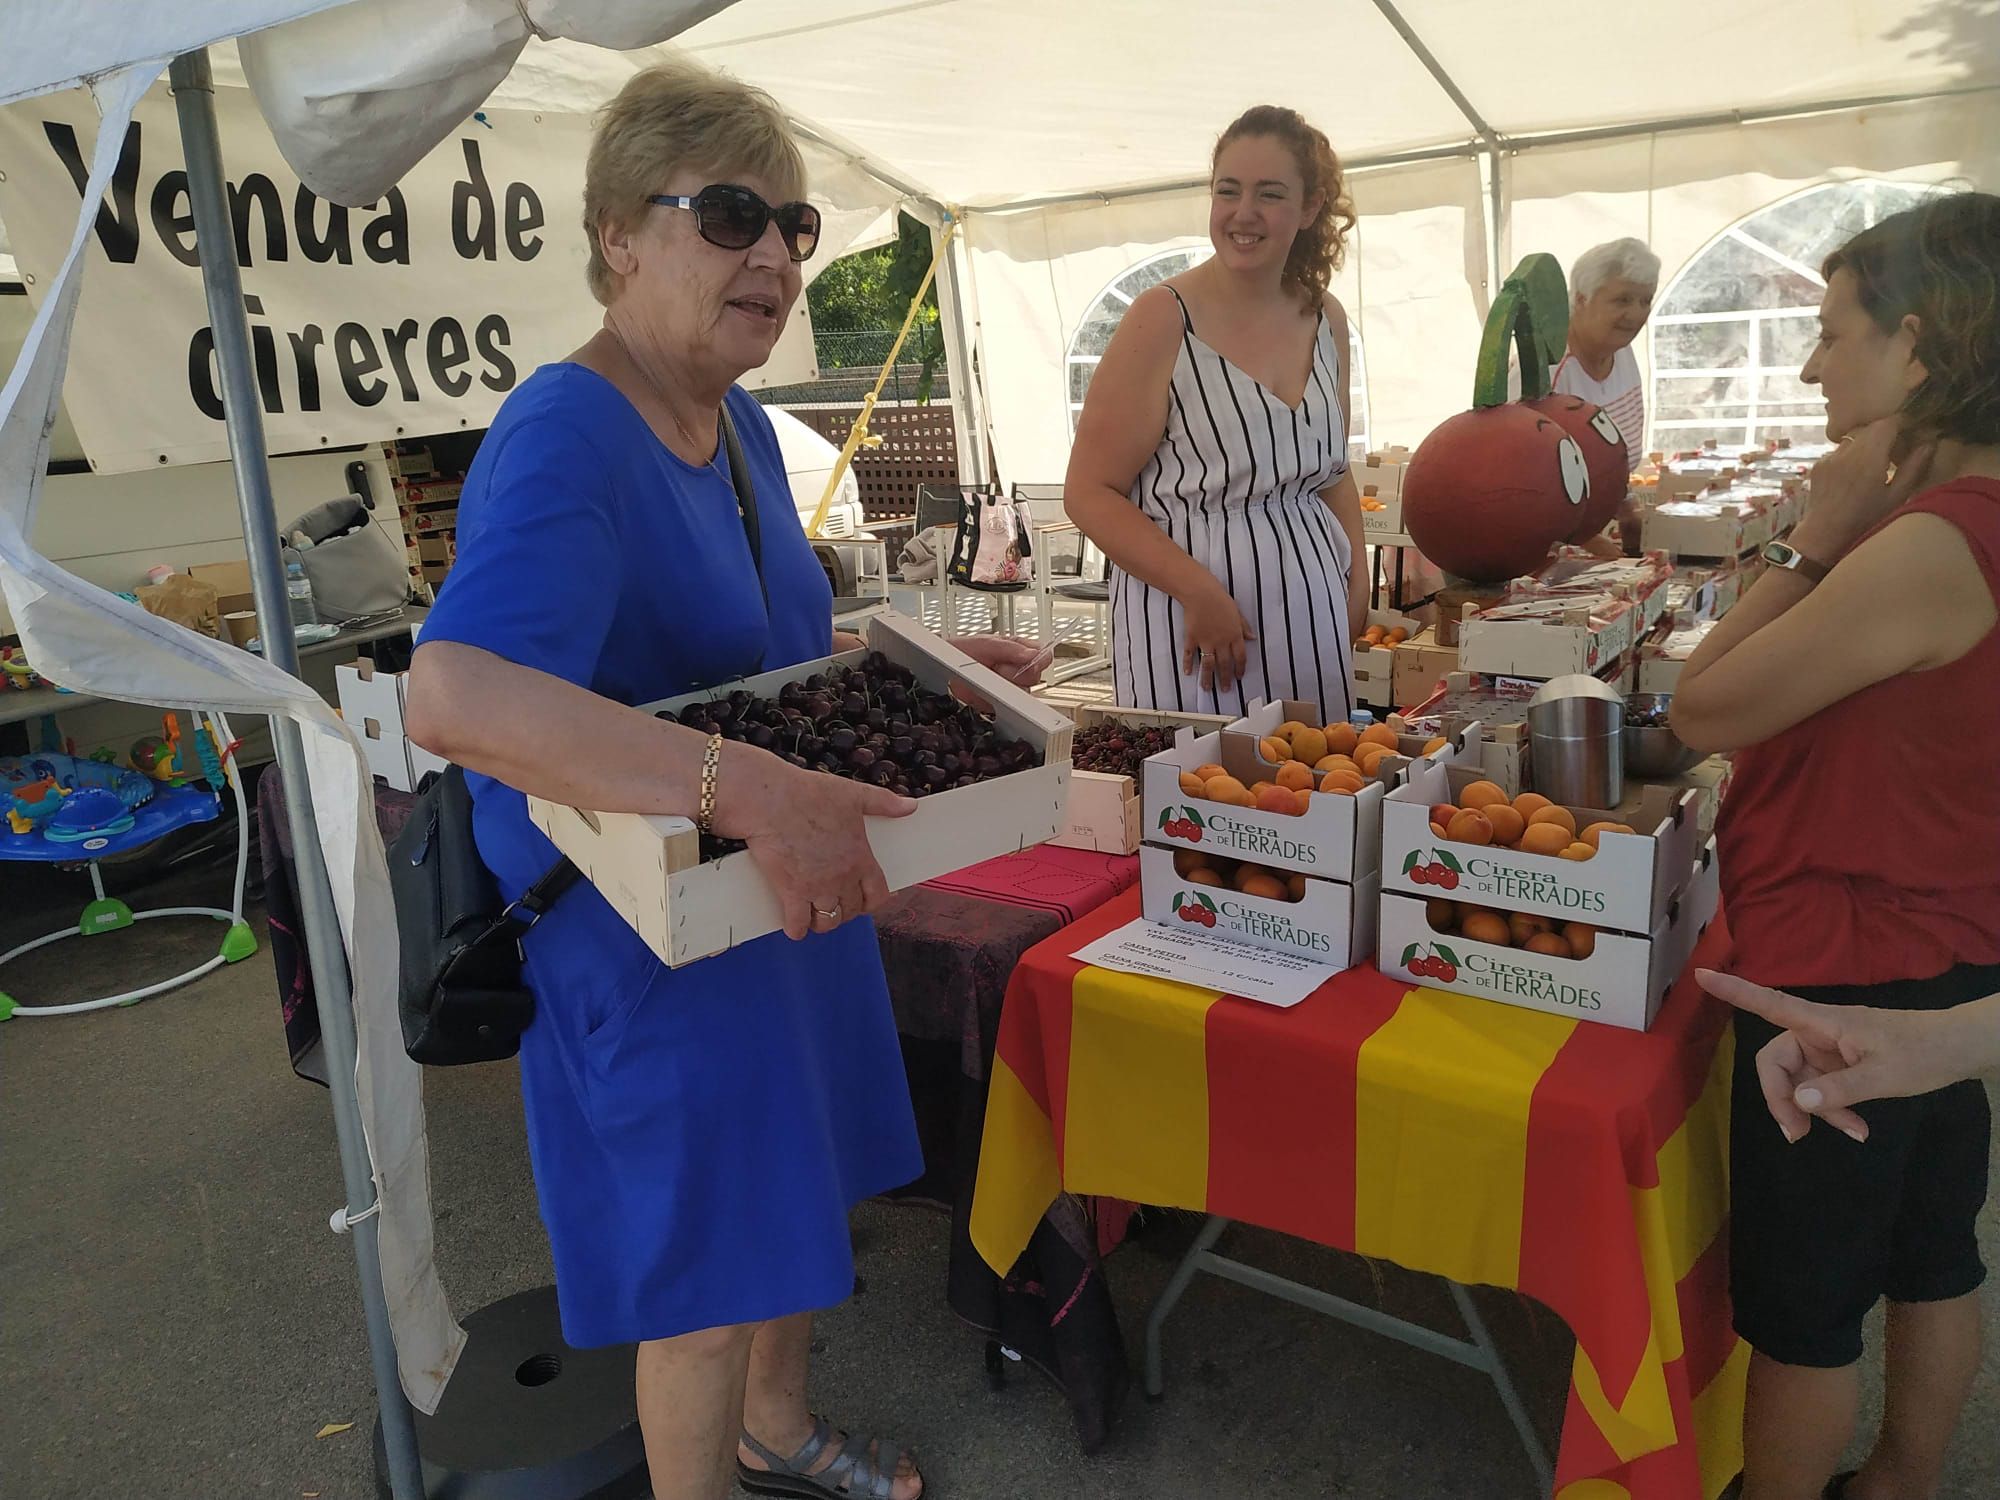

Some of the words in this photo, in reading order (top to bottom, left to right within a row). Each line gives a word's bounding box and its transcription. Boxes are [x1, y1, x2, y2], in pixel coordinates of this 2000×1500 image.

[42, 120, 410, 266] Venda
[451, 138, 545, 262] de
[188, 294, 516, 421] cireres
[1208, 815, 1279, 838] Cirera
[1217, 835, 1229, 845] DE
[1230, 831, 1316, 864] TERRADES
[1467, 858, 1558, 884] Cirera
[1478, 882, 1493, 893] DE
[1494, 876, 1605, 912] TERRADES
[1220, 901, 1291, 926] Cirera
[1231, 921, 1242, 931] DE
[1242, 918, 1330, 952] TERRADES
[1465, 954, 1554, 981] Cirera
[1476, 977, 1491, 988] DE
[1491, 972, 1602, 1011] TERRADES
